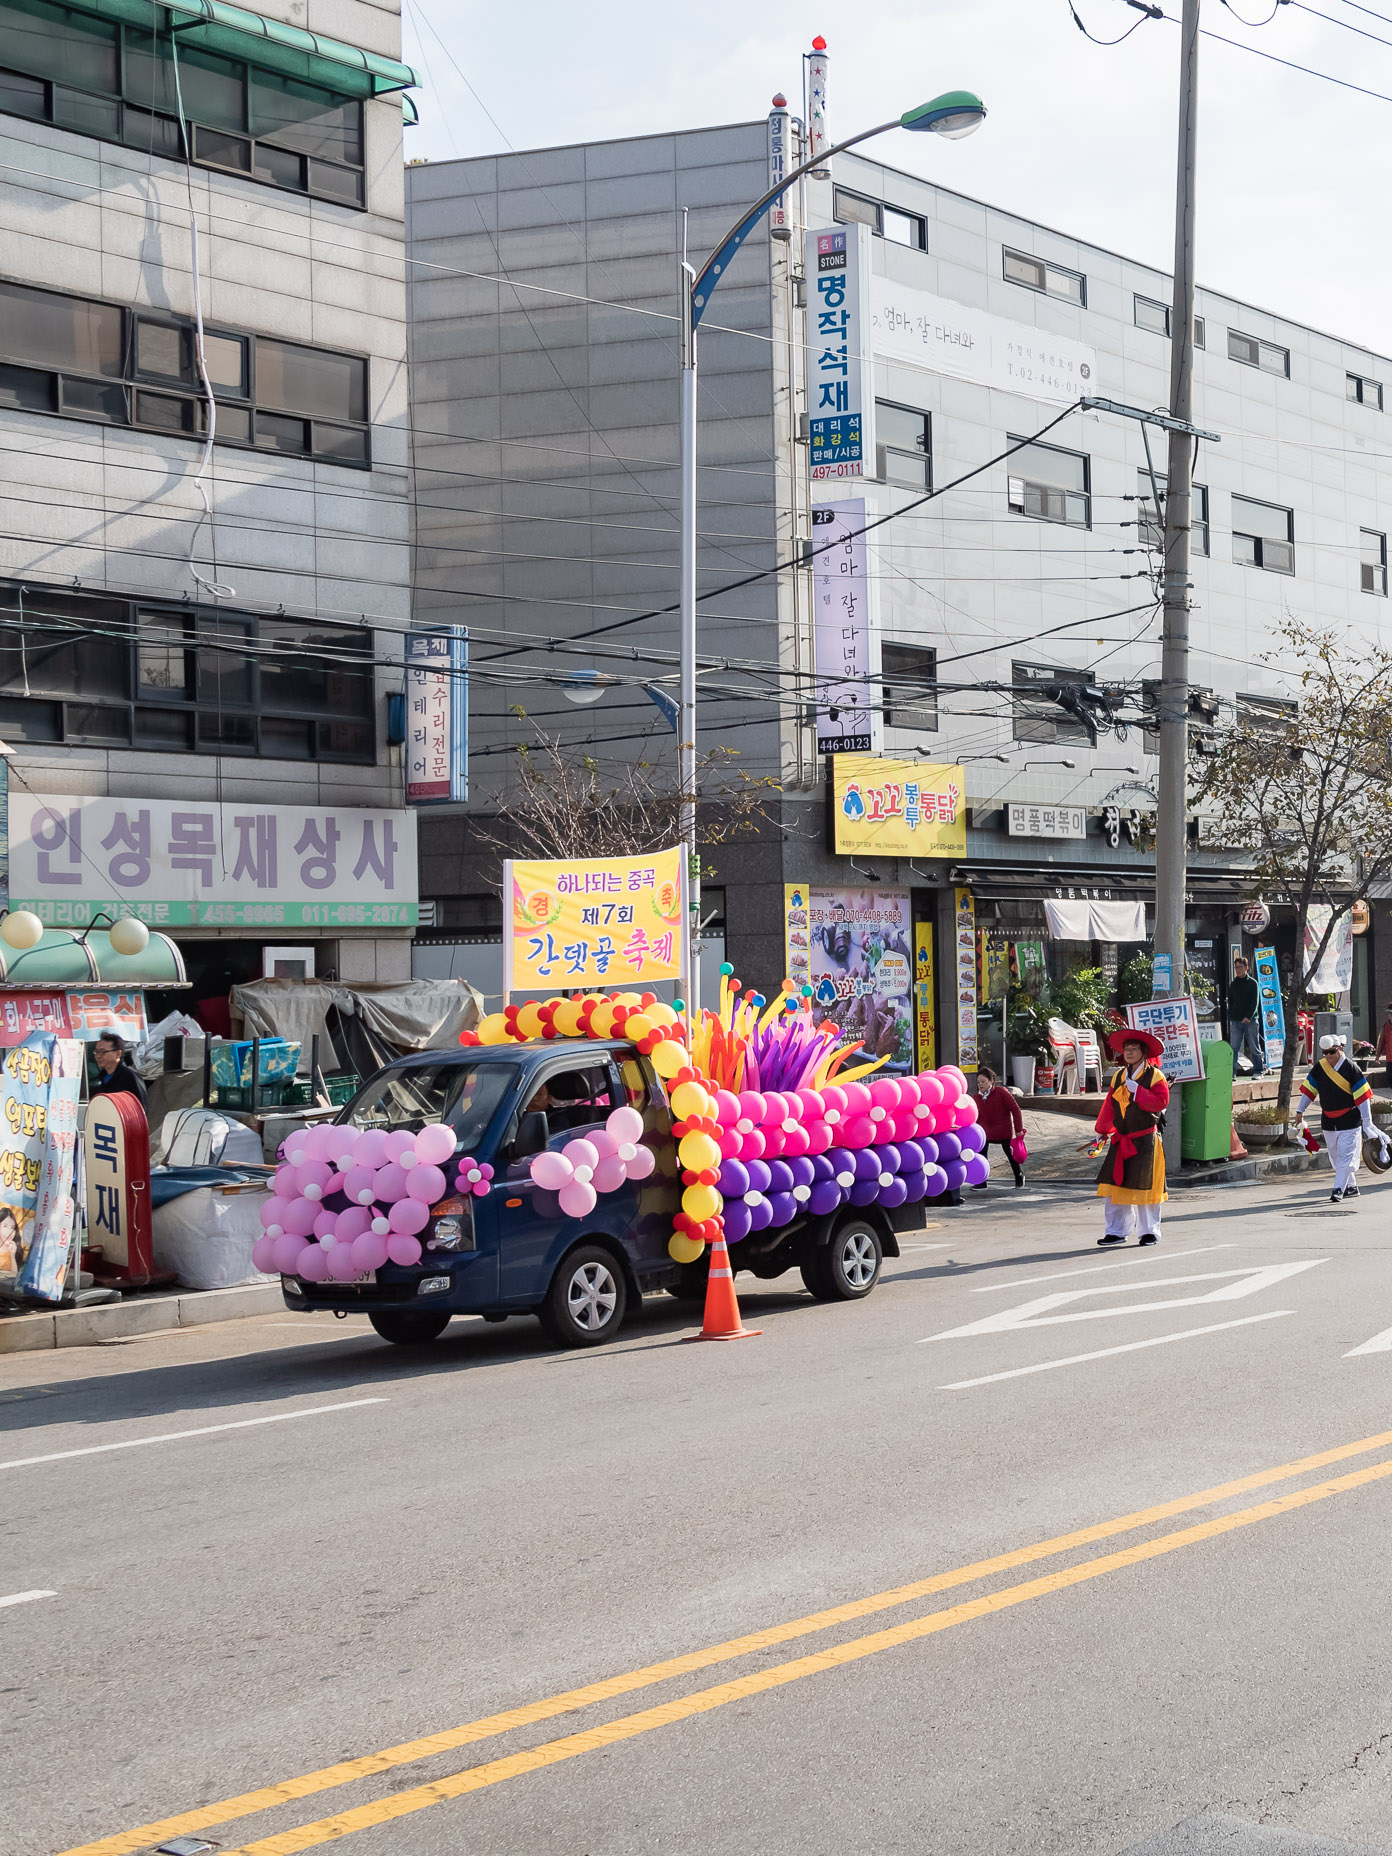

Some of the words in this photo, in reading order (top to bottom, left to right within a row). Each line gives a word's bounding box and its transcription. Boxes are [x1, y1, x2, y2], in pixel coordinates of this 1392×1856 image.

[820, 237, 844, 251] 名作
[820, 254, 846, 268] STONE
[817, 273, 851, 413] 명작석재
[917, 316, 931, 344] 잘
[935, 325, 975, 350] 다녀와
[1007, 362, 1092, 398] T.02-446-0123
[1081, 364, 1090, 377] 2F
[813, 416, 860, 433] 대리석
[813, 431, 860, 447] 화강석
[813, 445, 861, 462] 판매/시공
[812, 462, 862, 479] 497-0111
[816, 511, 830, 524] 2F
[841, 591, 858, 618] 잘
[412, 668, 428, 777] 인테리어
[819, 736, 870, 752] 446-0123
[905, 783, 919, 829] 봉투
[920, 792, 956, 822] 통닭
[1012, 808, 1083, 836] 명품떡볶이
[30, 806, 399, 891] 인성목재상사
[557, 872, 623, 894] 하나되는
[627, 868, 656, 889] 중곡
[532, 896, 549, 918] 경
[661, 887, 673, 908] 축
[18, 902, 91, 924] 인테리어
[581, 902, 635, 926] 제7회
[845, 909, 903, 924] 070-4408-5889
[526, 932, 617, 976] 간뎃골
[622, 927, 674, 972] 축제
[1138, 1004, 1189, 1027] 무단투기
[93, 1122, 121, 1237] 목재
